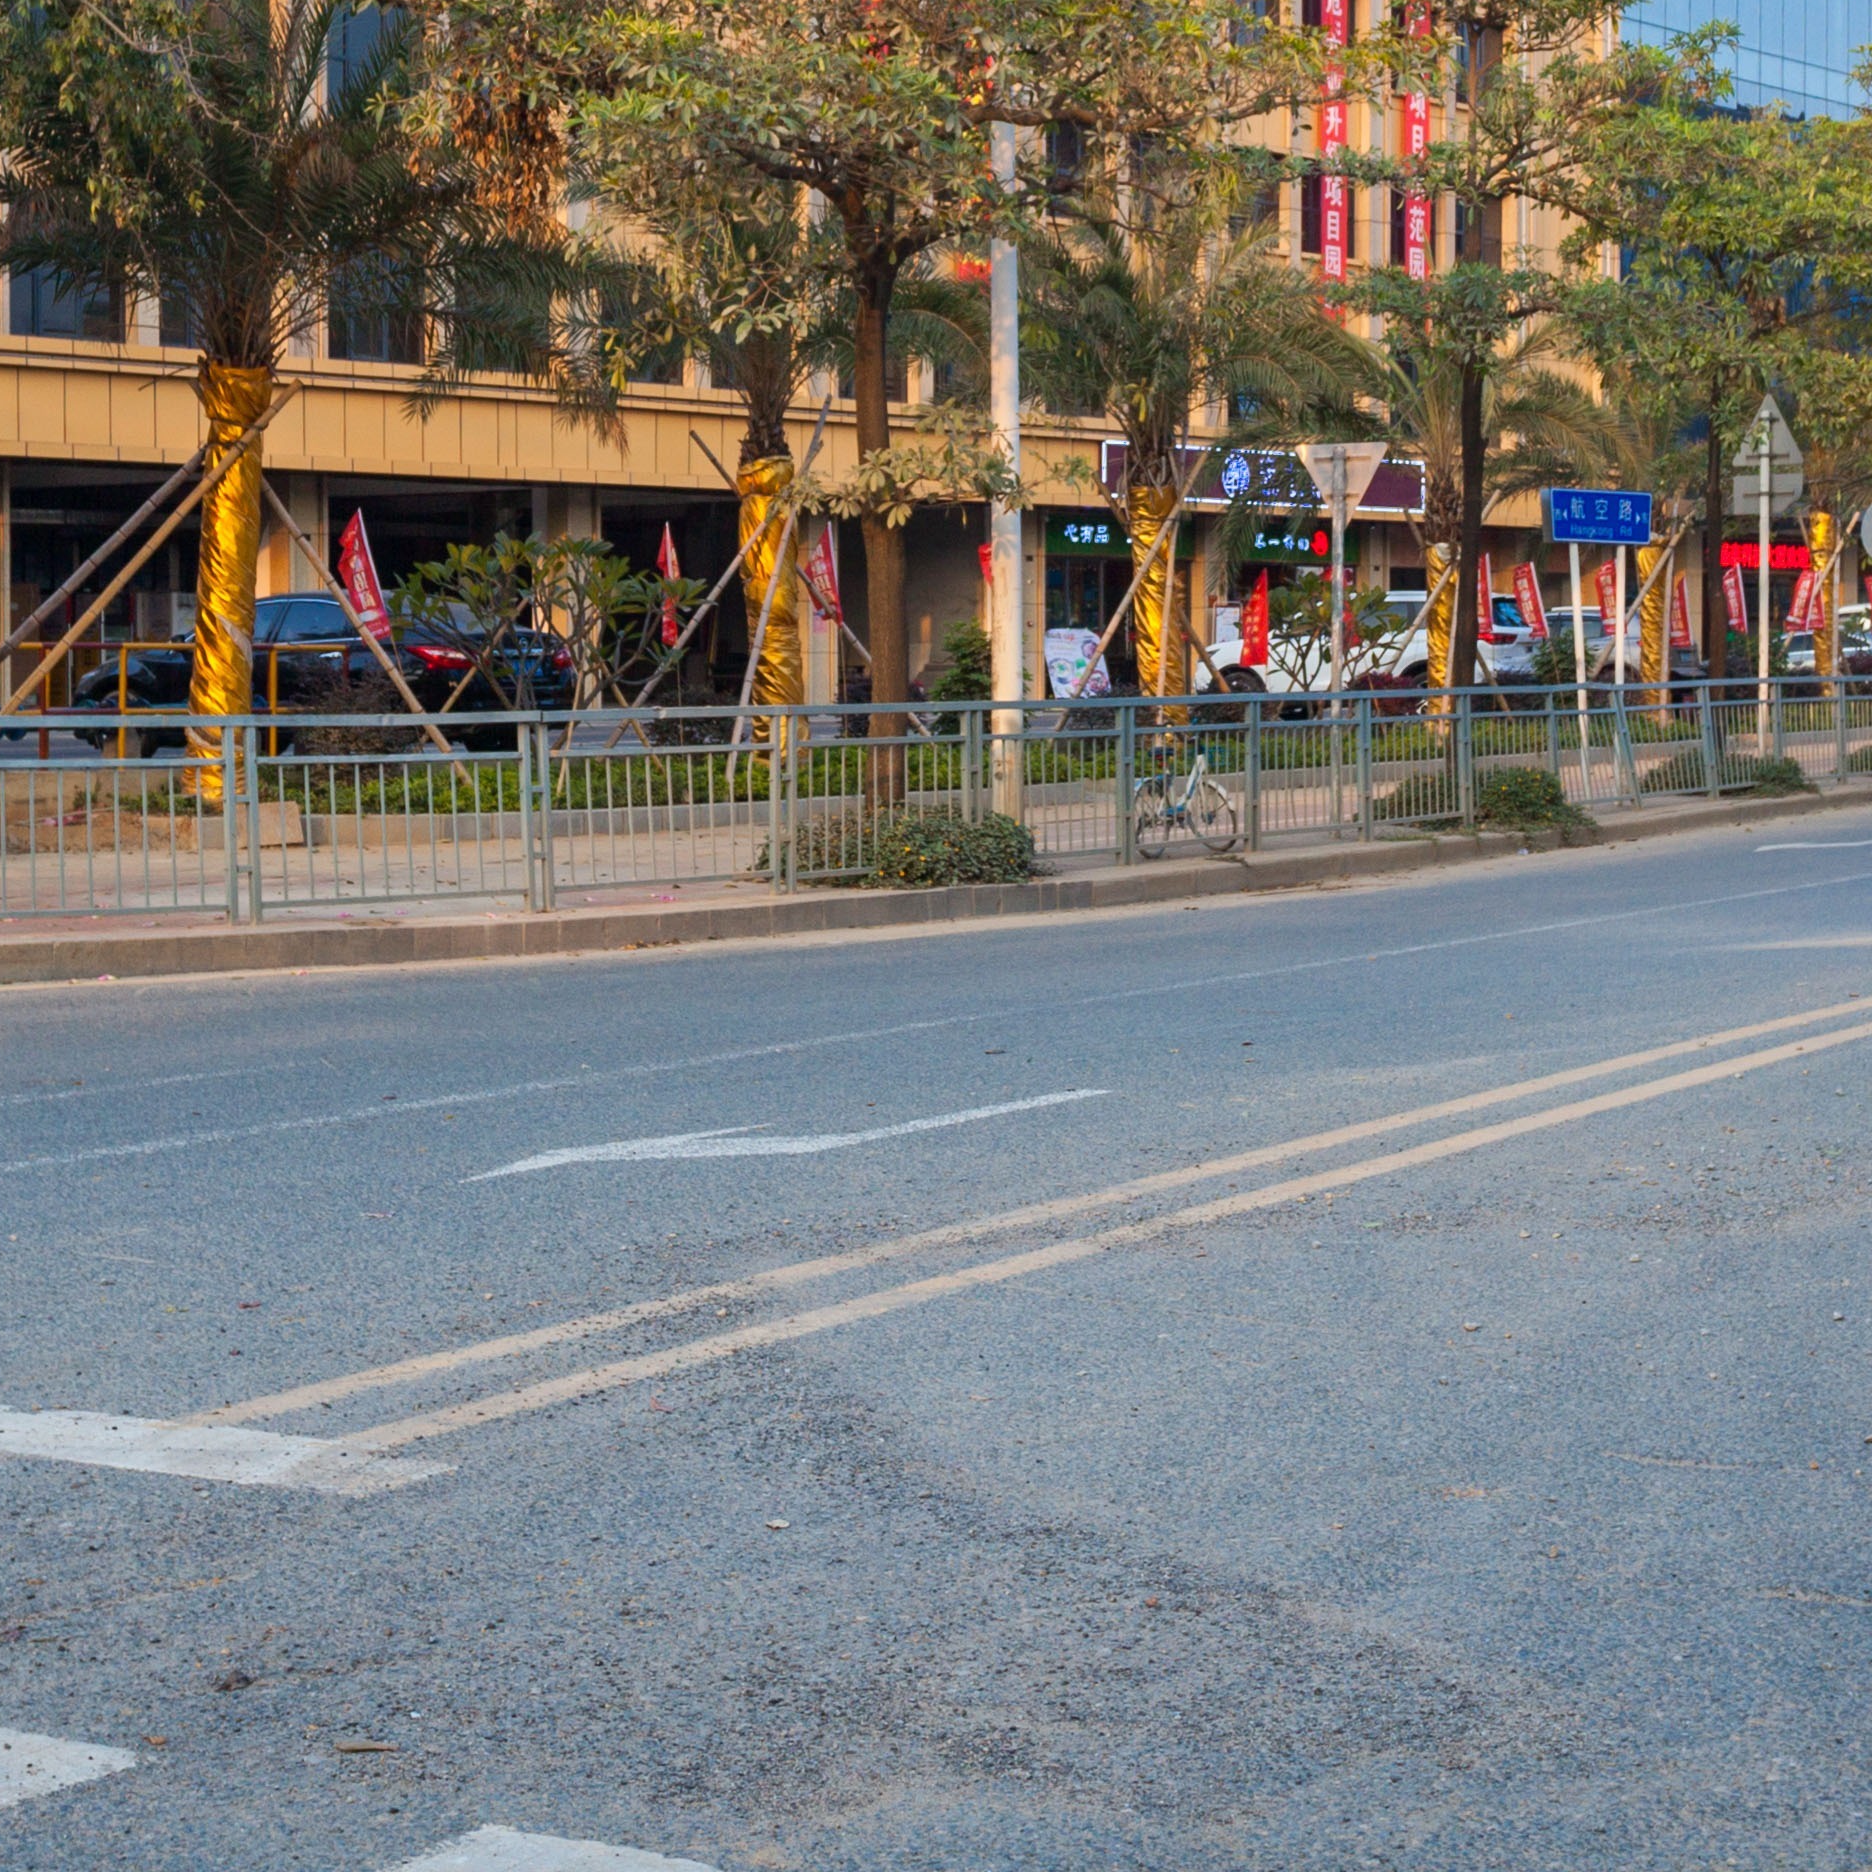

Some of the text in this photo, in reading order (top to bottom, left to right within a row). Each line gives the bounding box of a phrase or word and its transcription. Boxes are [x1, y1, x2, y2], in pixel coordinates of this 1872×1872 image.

[1570, 495, 1632, 522] 航空路
[1569, 524, 1633, 539] Hangkong Rd
